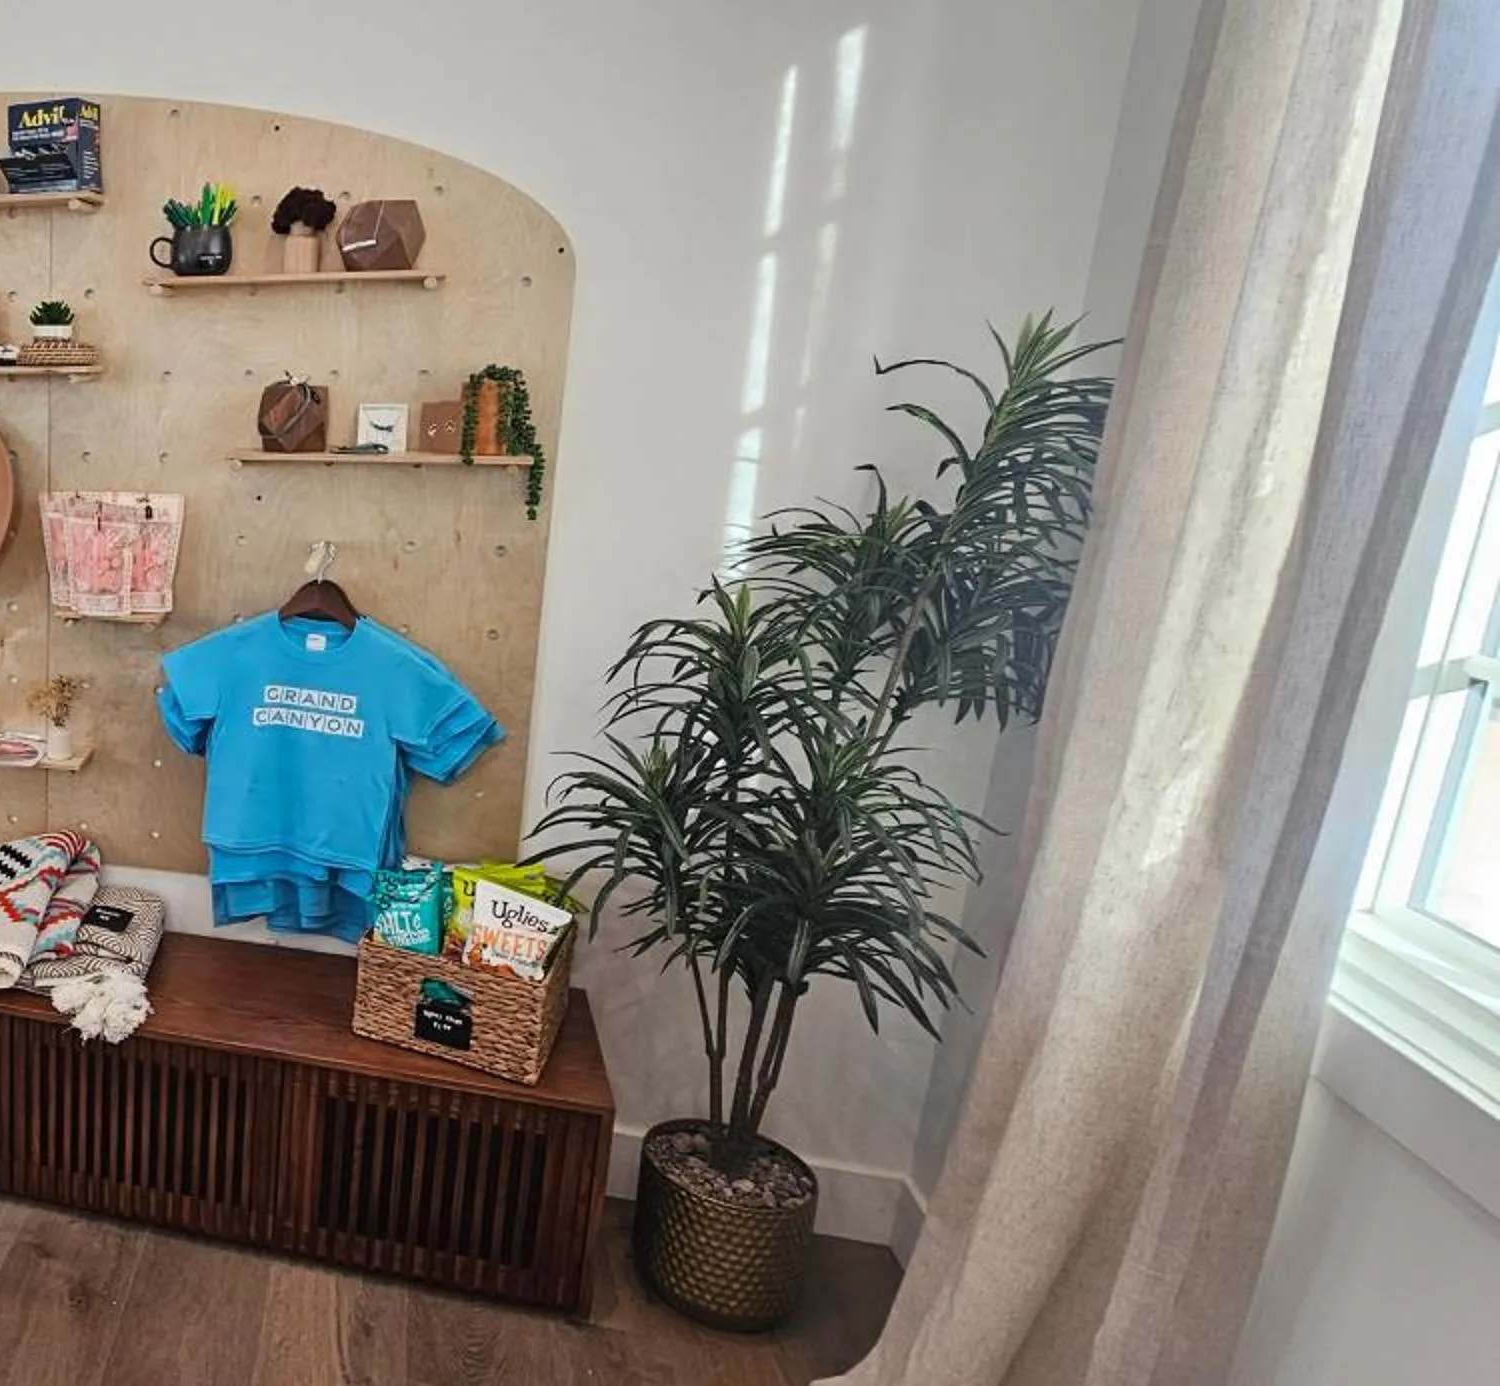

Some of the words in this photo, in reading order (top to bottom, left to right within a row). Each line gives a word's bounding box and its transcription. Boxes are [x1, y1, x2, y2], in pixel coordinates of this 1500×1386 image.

[18, 105, 66, 129] Advil
[266, 687, 354, 711] GRAND
[255, 709, 361, 735] CANYON
[491, 899, 549, 933] Uglies
[471, 925, 545, 961] SWEETS
